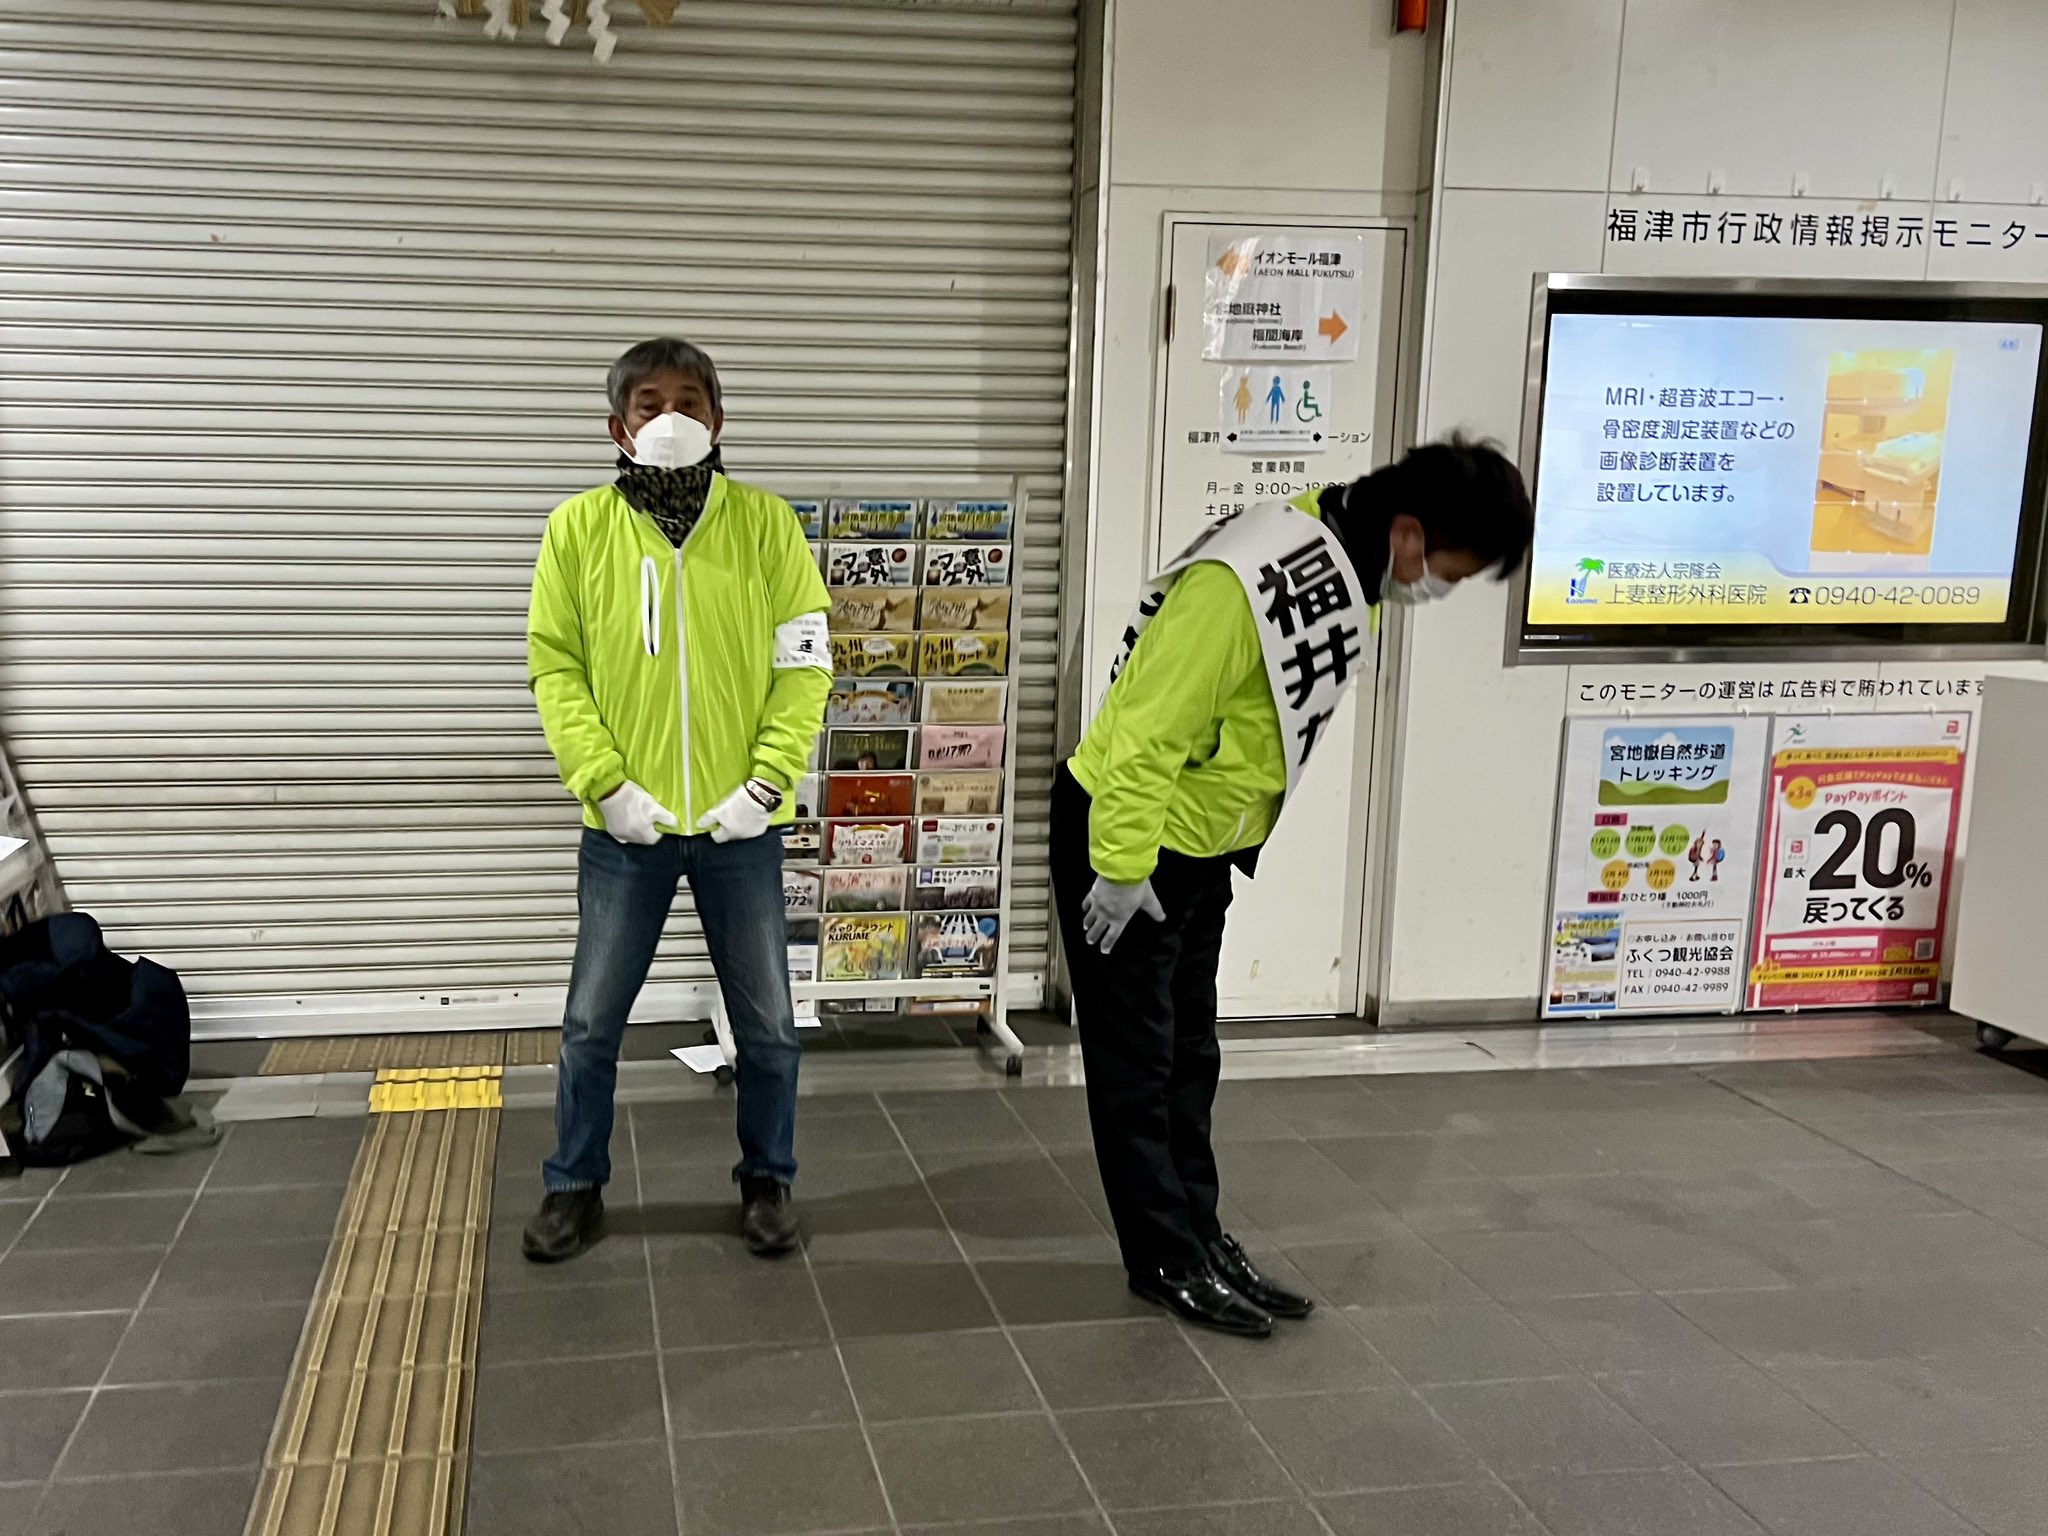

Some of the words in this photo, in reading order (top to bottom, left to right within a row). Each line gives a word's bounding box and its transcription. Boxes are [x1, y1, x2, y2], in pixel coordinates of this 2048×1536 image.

[1254, 252, 1341, 266] イオンモール福津
[1286, 269, 1310, 278] MALL
[1603, 419, 1795, 440] 骨密度測定装置などの
[1251, 461, 1305, 473] 営業時間
[1599, 451, 1736, 472] 画像診断装置を
[1597, 483, 1735, 503] 設置しています。
[1607, 562, 1722, 580] 医療法人宗隆会
[1605, 583, 1768, 606] 上妻整形外科医院
[1815, 586, 1980, 605] 0940-42-0089
[1610, 744, 1726, 761] 宮地嶽自然歩道
[1620, 765, 1717, 782] トレッキング
[1825, 790, 1908, 805] PayPayポイント
[1676, 890, 1708, 900] 1000円
[1803, 896, 1904, 924] 戻ってくる
[828, 932, 870, 941] KURUME
[1626, 945, 1734, 964] ふくつ観光協会
[1627, 970, 1645, 979] TEL
[1655, 966, 1731, 977] 0940-42-9988
[1653, 982, 1729, 994] 0940-42-9989
